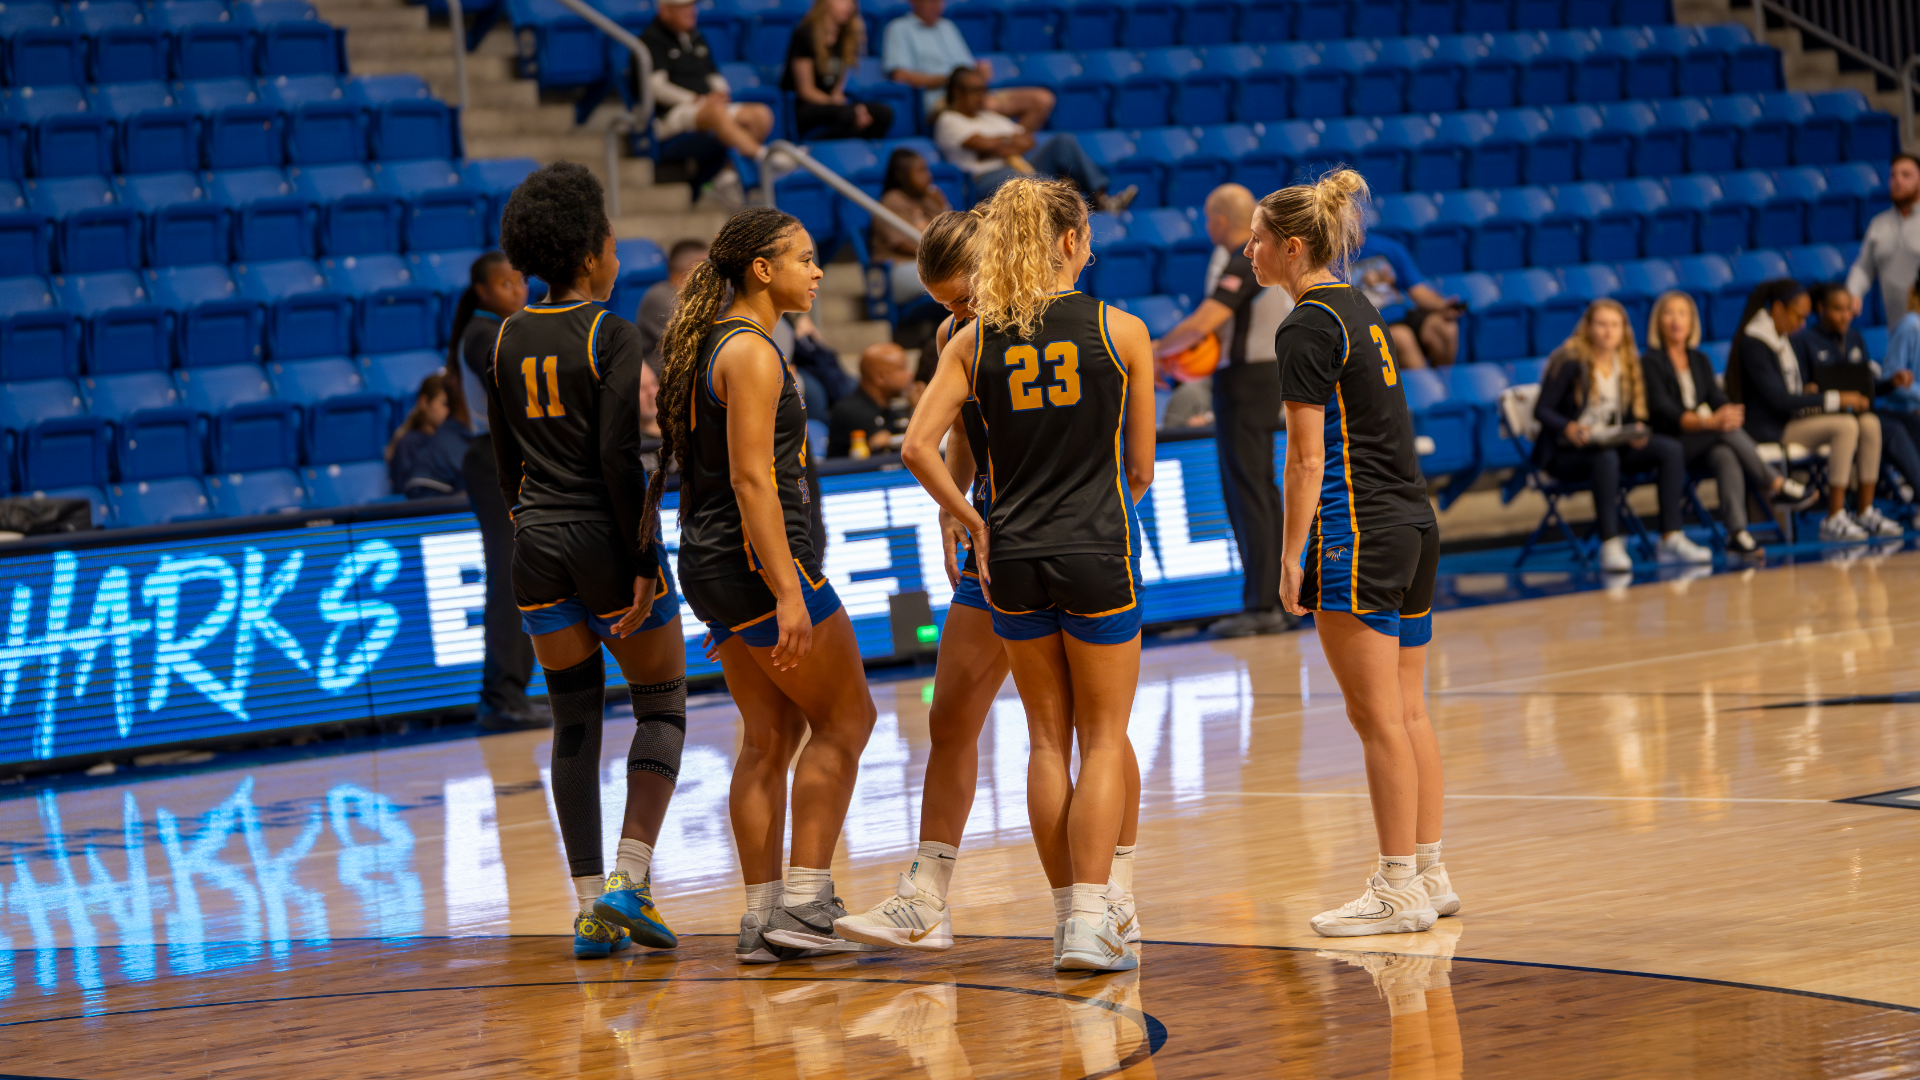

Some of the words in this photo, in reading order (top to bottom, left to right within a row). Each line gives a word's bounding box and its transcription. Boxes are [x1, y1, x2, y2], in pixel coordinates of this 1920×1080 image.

[521, 355, 567, 420] 11
[1003, 340, 1083, 412] 23
[1368, 323, 1397, 388] 3
[0, 538, 400, 760] HARKS
